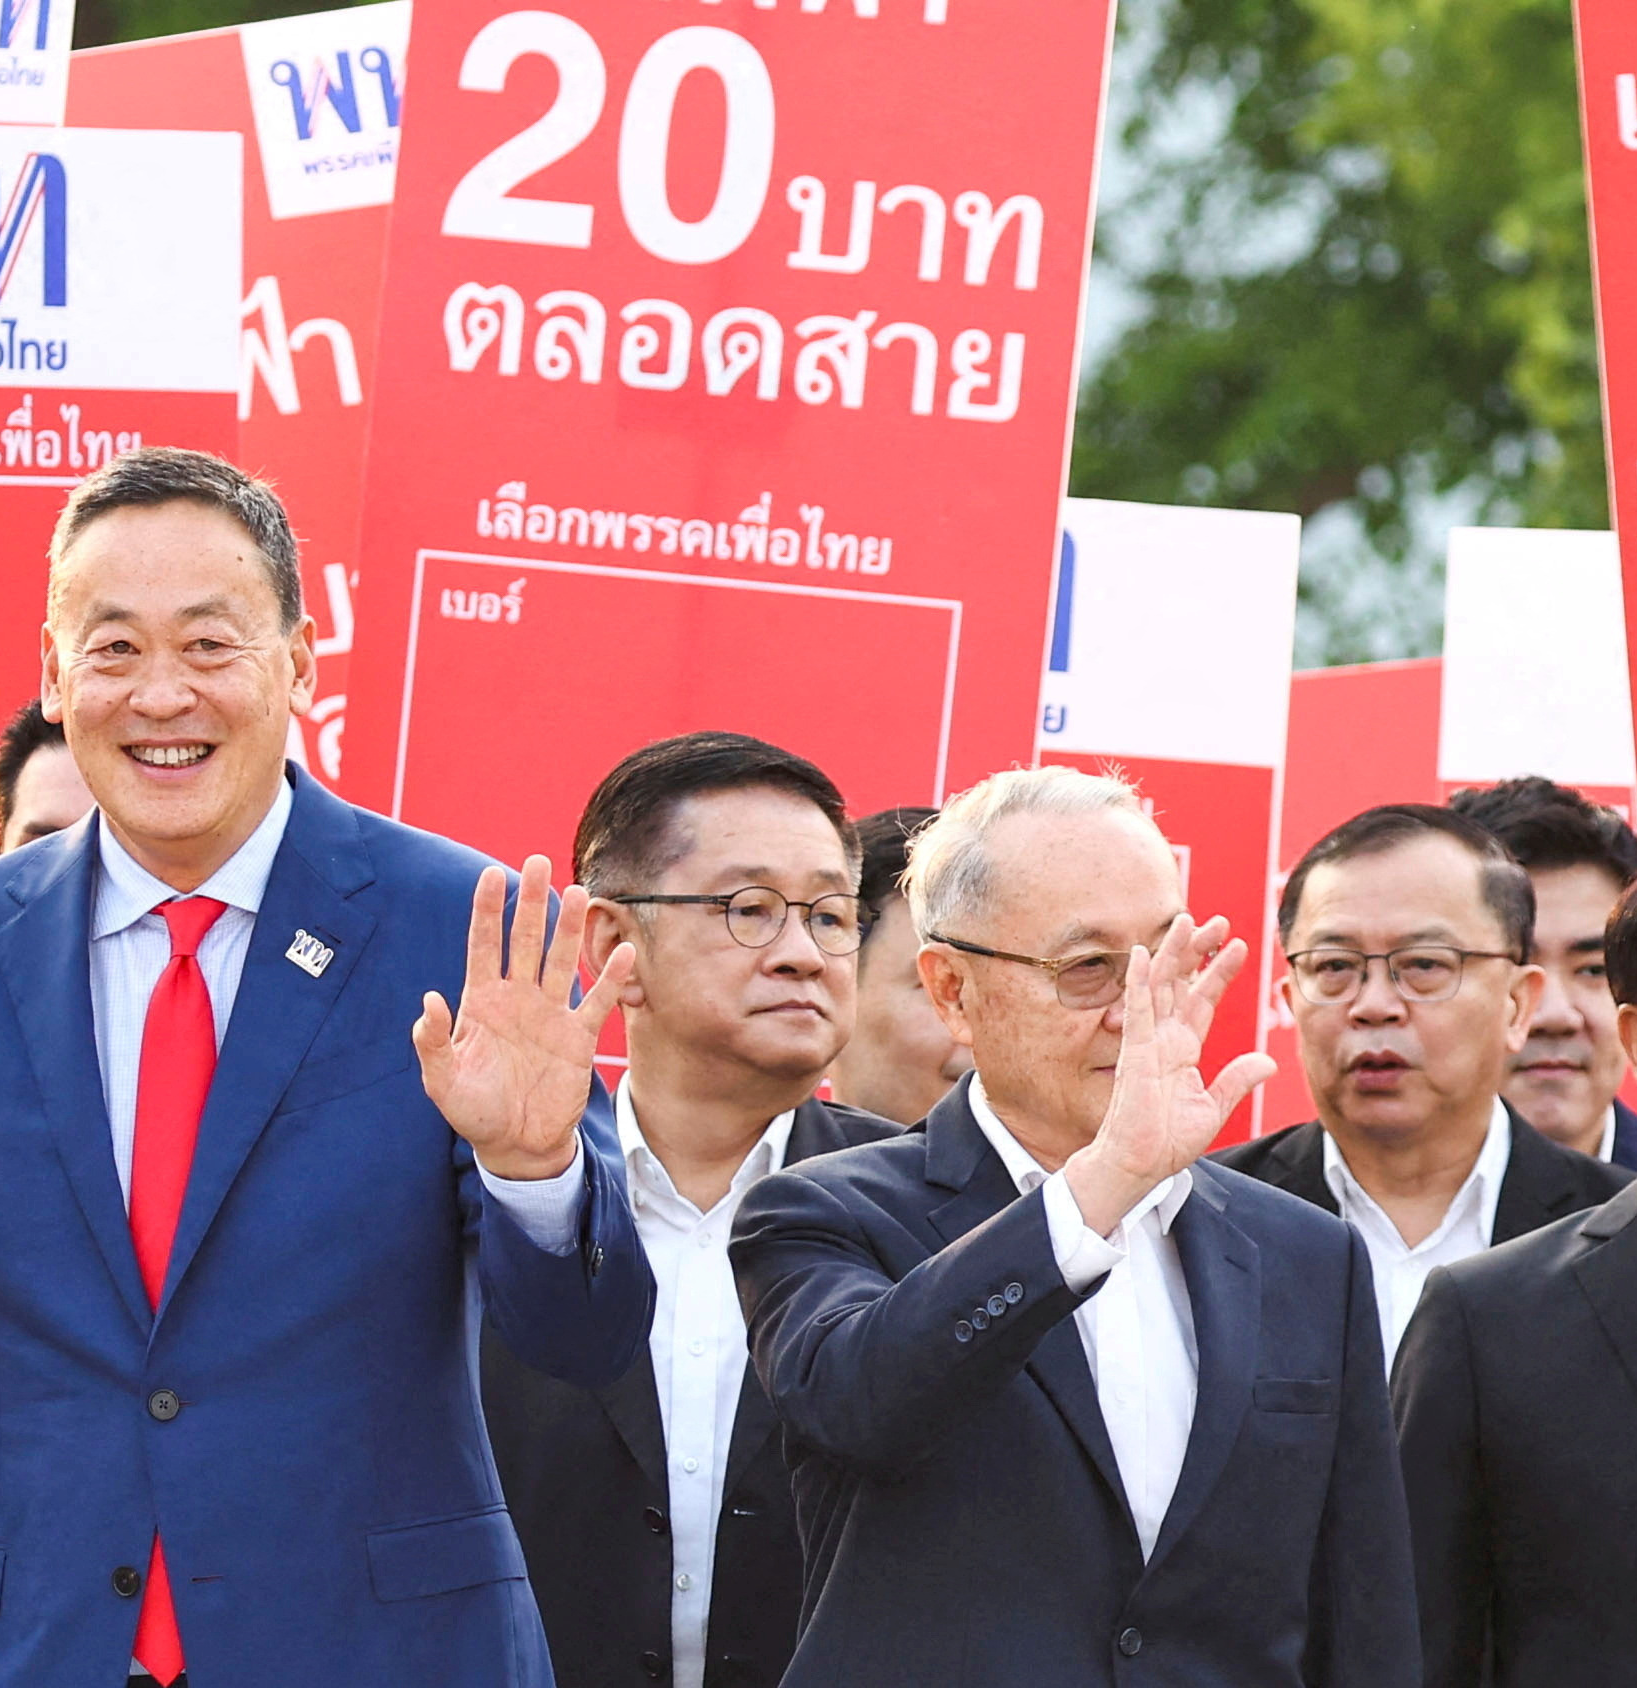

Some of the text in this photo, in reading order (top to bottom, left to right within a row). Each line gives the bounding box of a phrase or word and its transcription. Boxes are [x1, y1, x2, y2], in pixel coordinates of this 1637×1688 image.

[442, 10, 1043, 290] 20 บาท
[443, 281, 1026, 423] ตลอดสาย
[475, 481, 892, 576] เลือกพรรคเพื่อไทย
[441, 578, 526, 623] เบอร์
